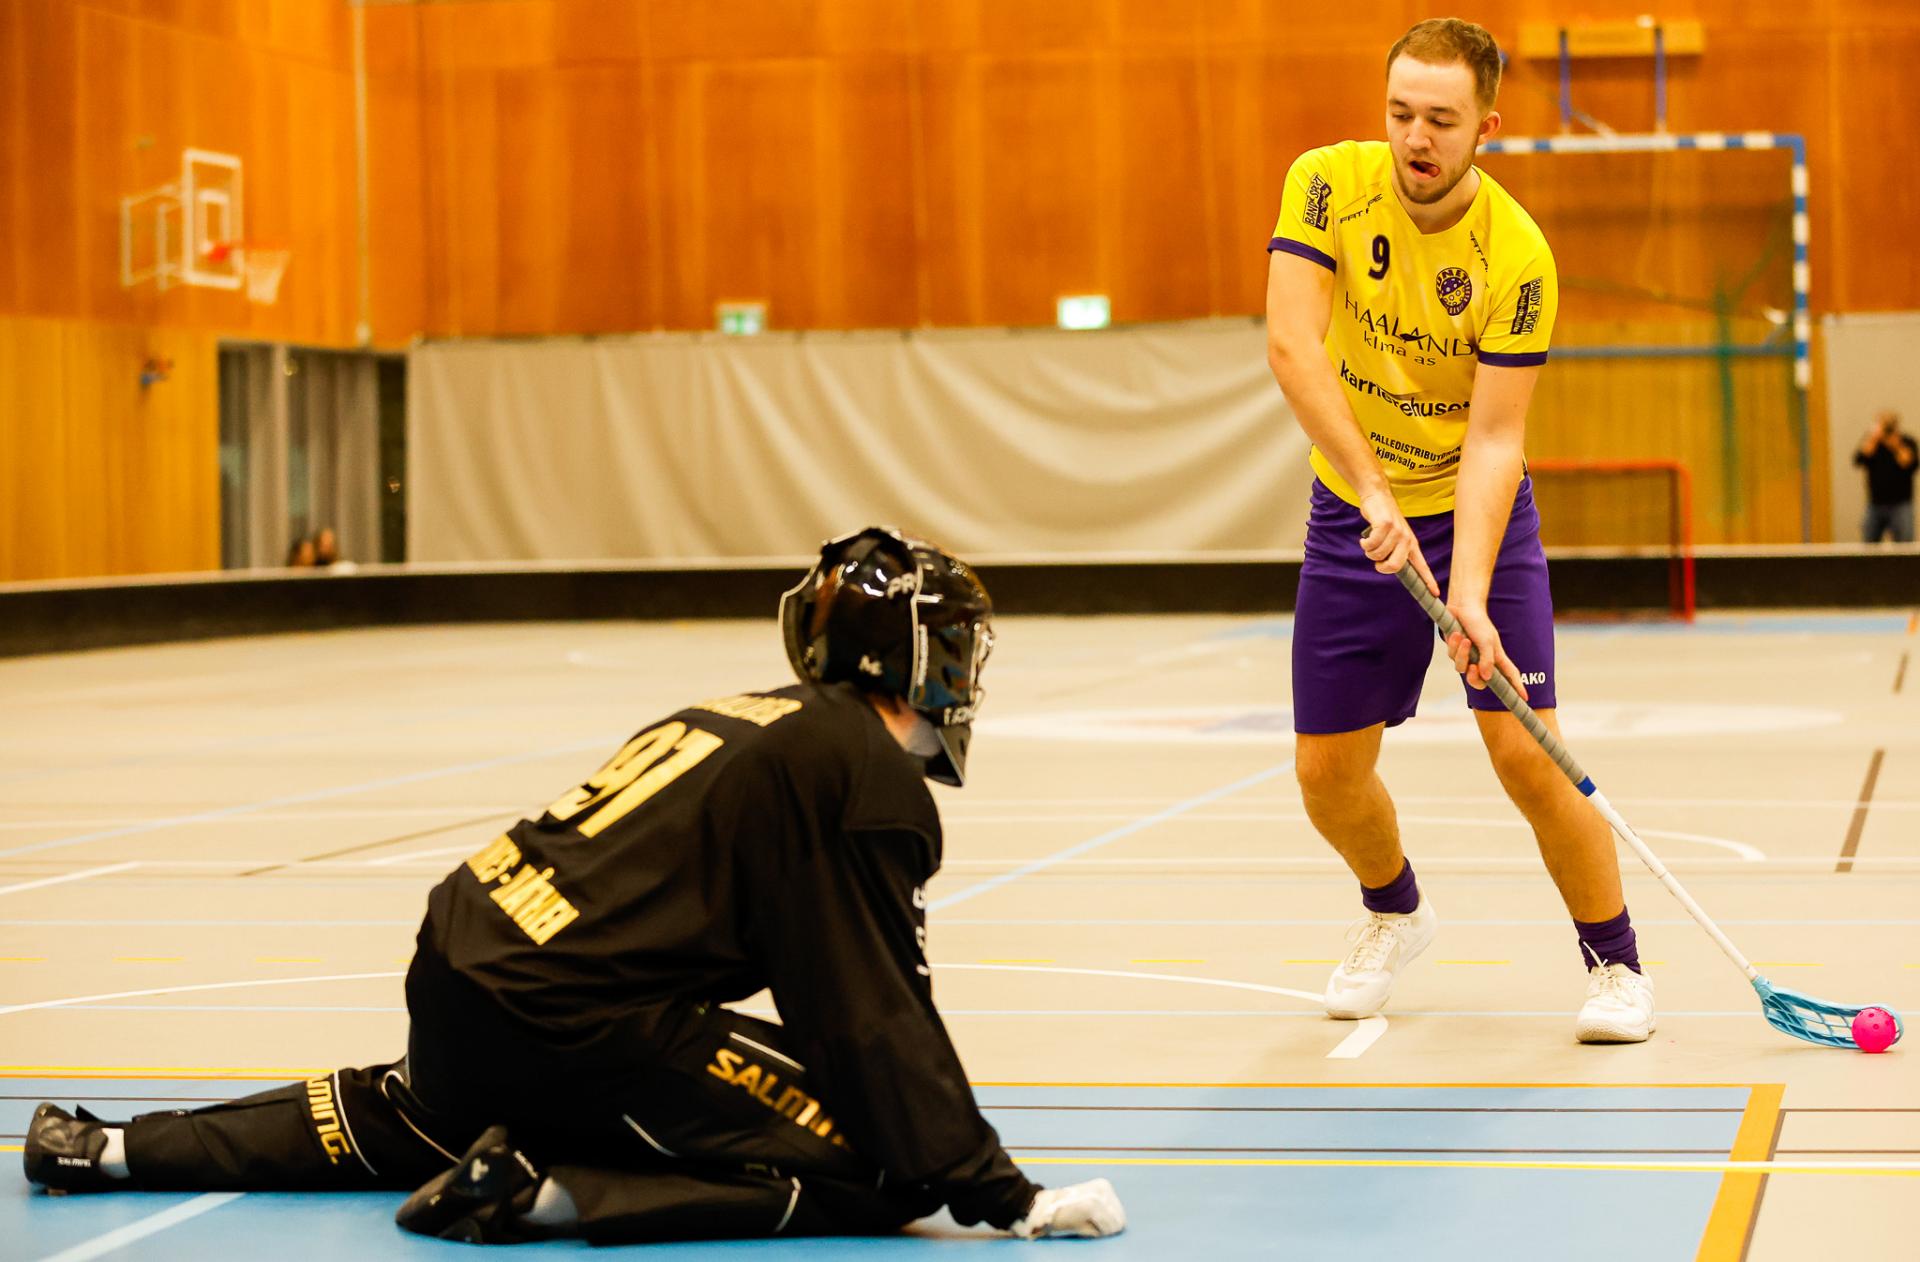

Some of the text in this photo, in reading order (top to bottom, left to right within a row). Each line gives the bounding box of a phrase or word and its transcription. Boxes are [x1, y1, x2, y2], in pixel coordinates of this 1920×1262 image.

[1368, 234, 1391, 280] 9
[1345, 290, 1475, 358] HAALAND
[1364, 330, 1437, 367] klma as
[1375, 446, 1417, 471] kjøp/salg
[1520, 671, 1547, 686] AKO
[548, 720, 725, 839] 91
[706, 1048, 844, 1147] SALM
